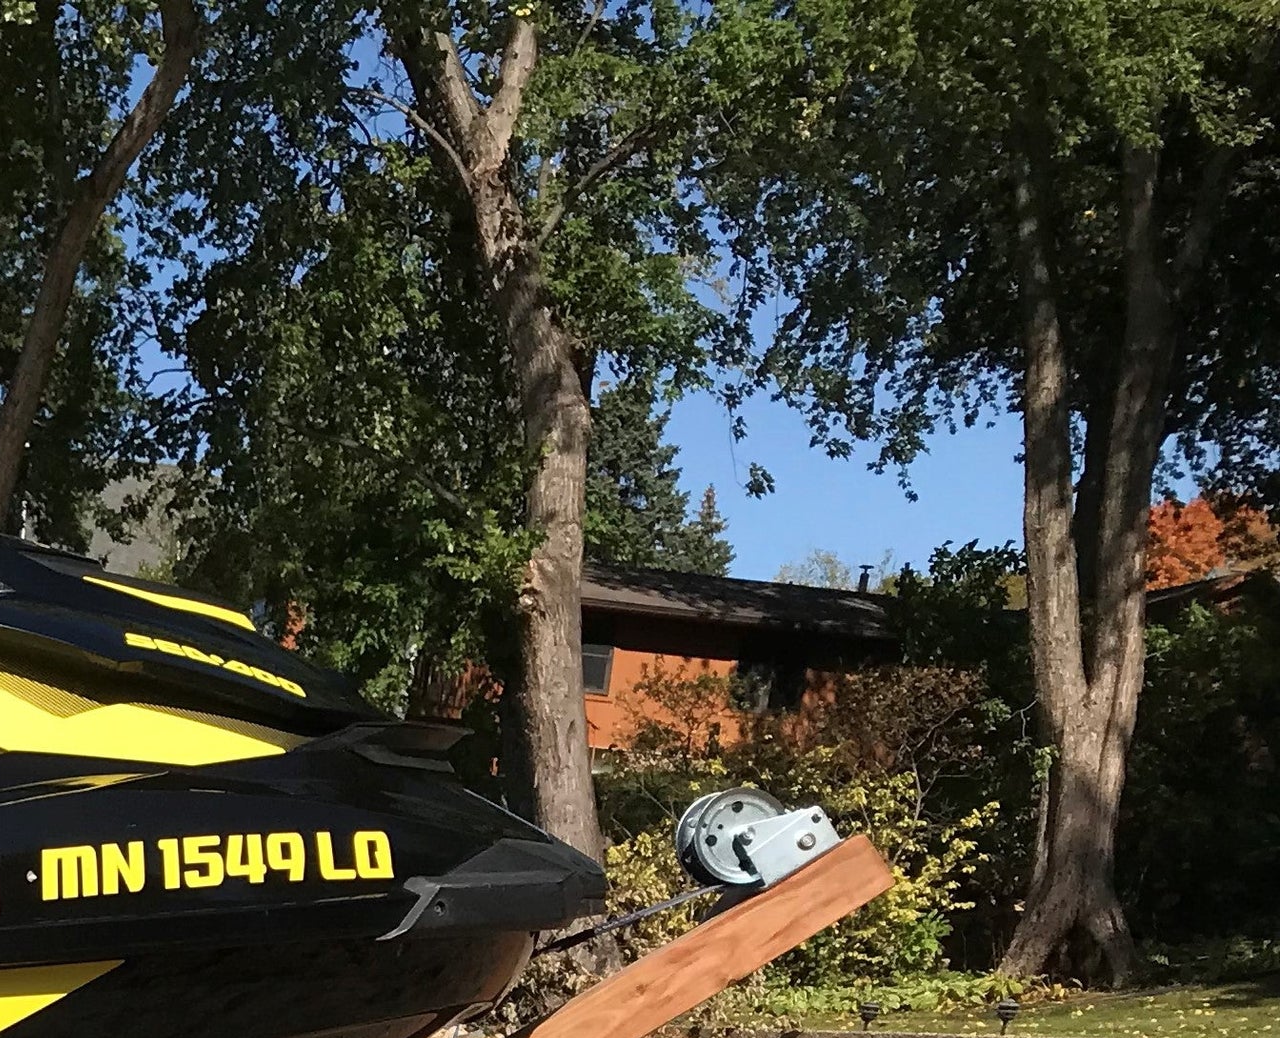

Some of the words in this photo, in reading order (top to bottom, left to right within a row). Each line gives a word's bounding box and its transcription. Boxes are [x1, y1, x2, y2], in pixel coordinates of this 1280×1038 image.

[41, 841, 145, 901] MN
[158, 832, 306, 890] 1549
[316, 831, 395, 881] LQ
